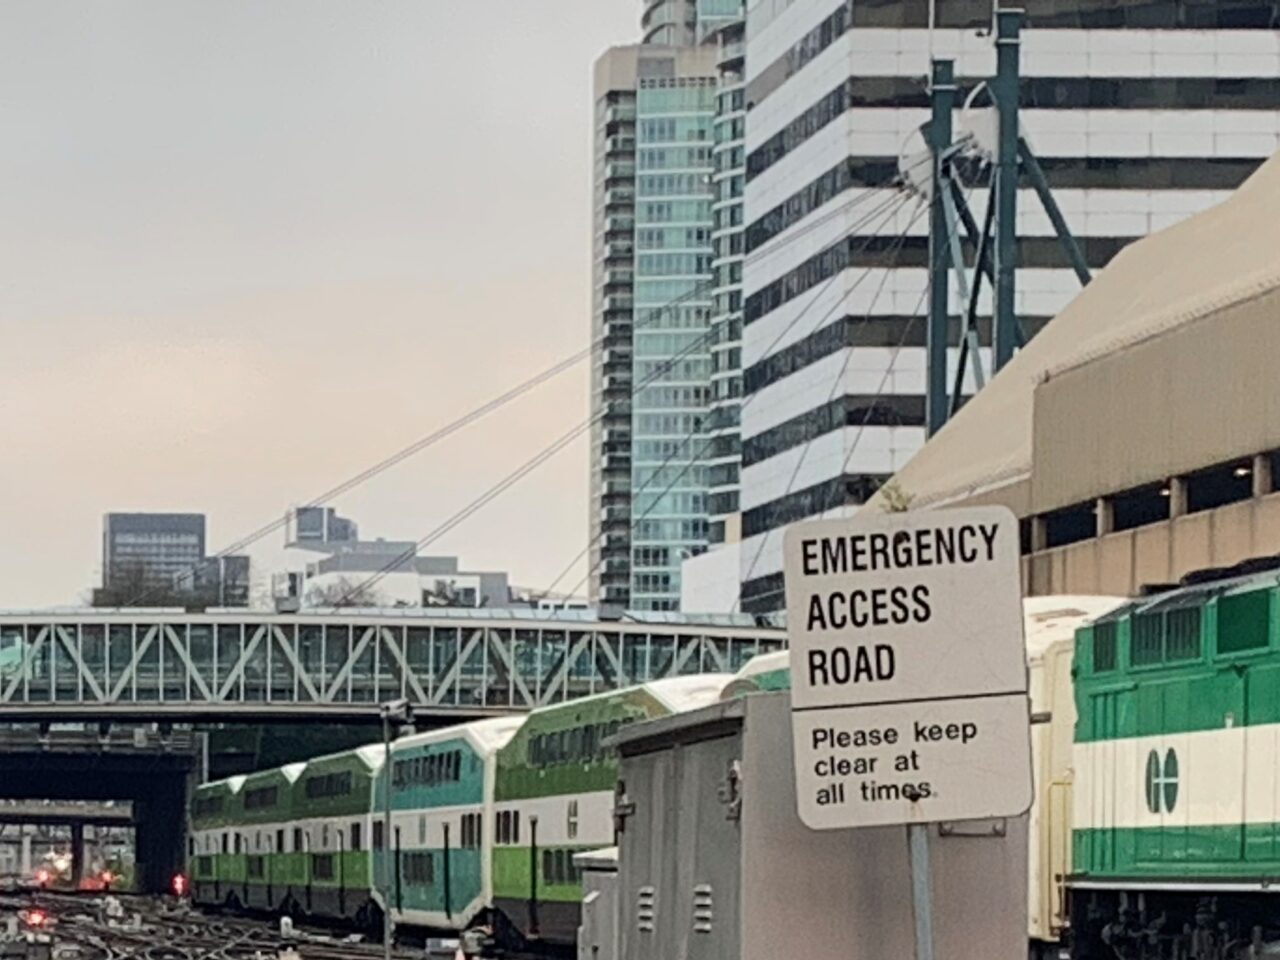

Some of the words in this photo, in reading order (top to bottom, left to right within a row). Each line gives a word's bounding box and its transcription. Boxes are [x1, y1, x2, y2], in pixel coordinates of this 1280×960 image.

[801, 523, 998, 576] EMERGENCY
[807, 584, 931, 631] ACCESS
[808, 644, 895, 686] ROAD
[812, 727, 898, 750] Please
[913, 721, 977, 744] keep
[814, 756, 878, 777] clear
[894, 750, 920, 772] at
[816, 783, 845, 806] all
